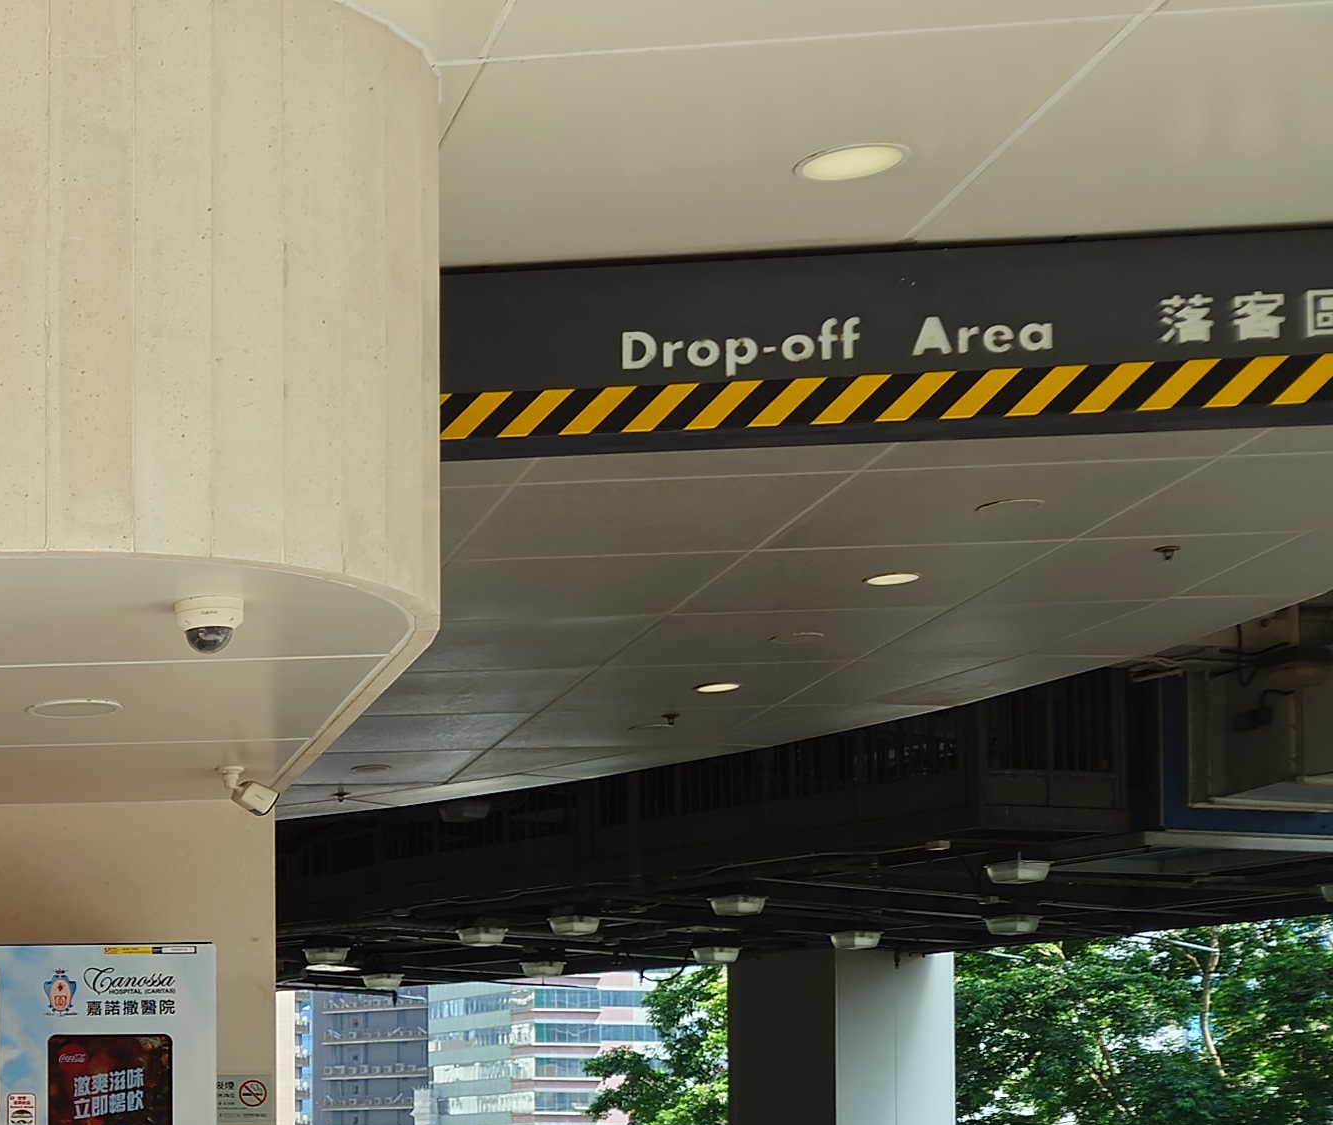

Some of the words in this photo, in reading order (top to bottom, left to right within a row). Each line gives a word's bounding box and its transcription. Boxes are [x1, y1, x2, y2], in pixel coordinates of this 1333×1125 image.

[621, 317, 860, 376] Drop-off
[913, 316, 1054, 357] Area
[83, 967, 176, 995] Canossa
[86, 999, 175, 1016] 嘉諾撒醫院
[59, 1053, 86, 1063] Coca-Cola
[73, 1067, 144, 1097] 激爽滋味
[73, 1090, 144, 1119] 立即暢飲
